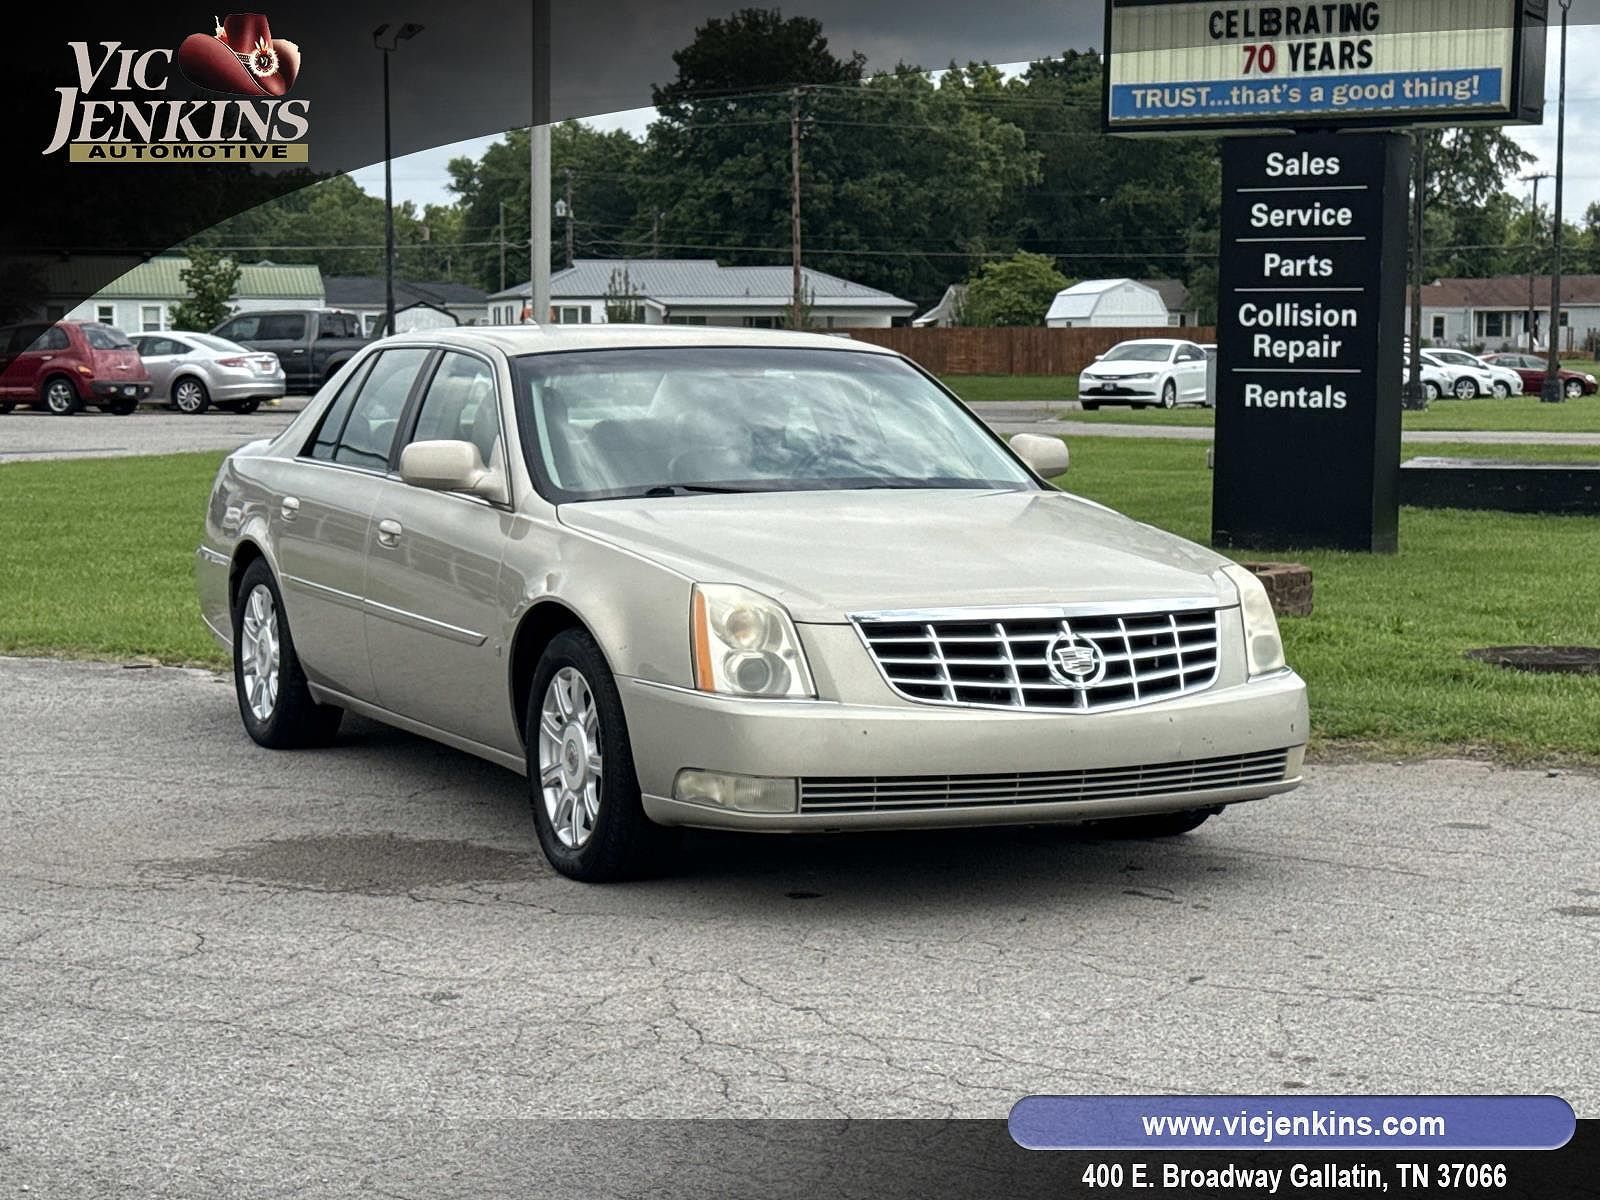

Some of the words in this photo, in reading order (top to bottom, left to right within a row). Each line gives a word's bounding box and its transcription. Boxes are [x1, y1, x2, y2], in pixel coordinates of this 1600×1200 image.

[1242, 44, 1276, 74] 70
[1287, 39, 1373, 72] YEARS
[1309, 86, 1324, 102] a
[1332, 79, 1395, 105] good
[1402, 75, 1480, 100] thing!
[1265, 151, 1341, 177] Sales
[1250, 202, 1353, 228] Service
[1263, 253, 1334, 277] Parts
[1238, 303, 1357, 327] Collision
[1253, 334, 1342, 363] Repair
[1244, 384, 1348, 409] Rentals
